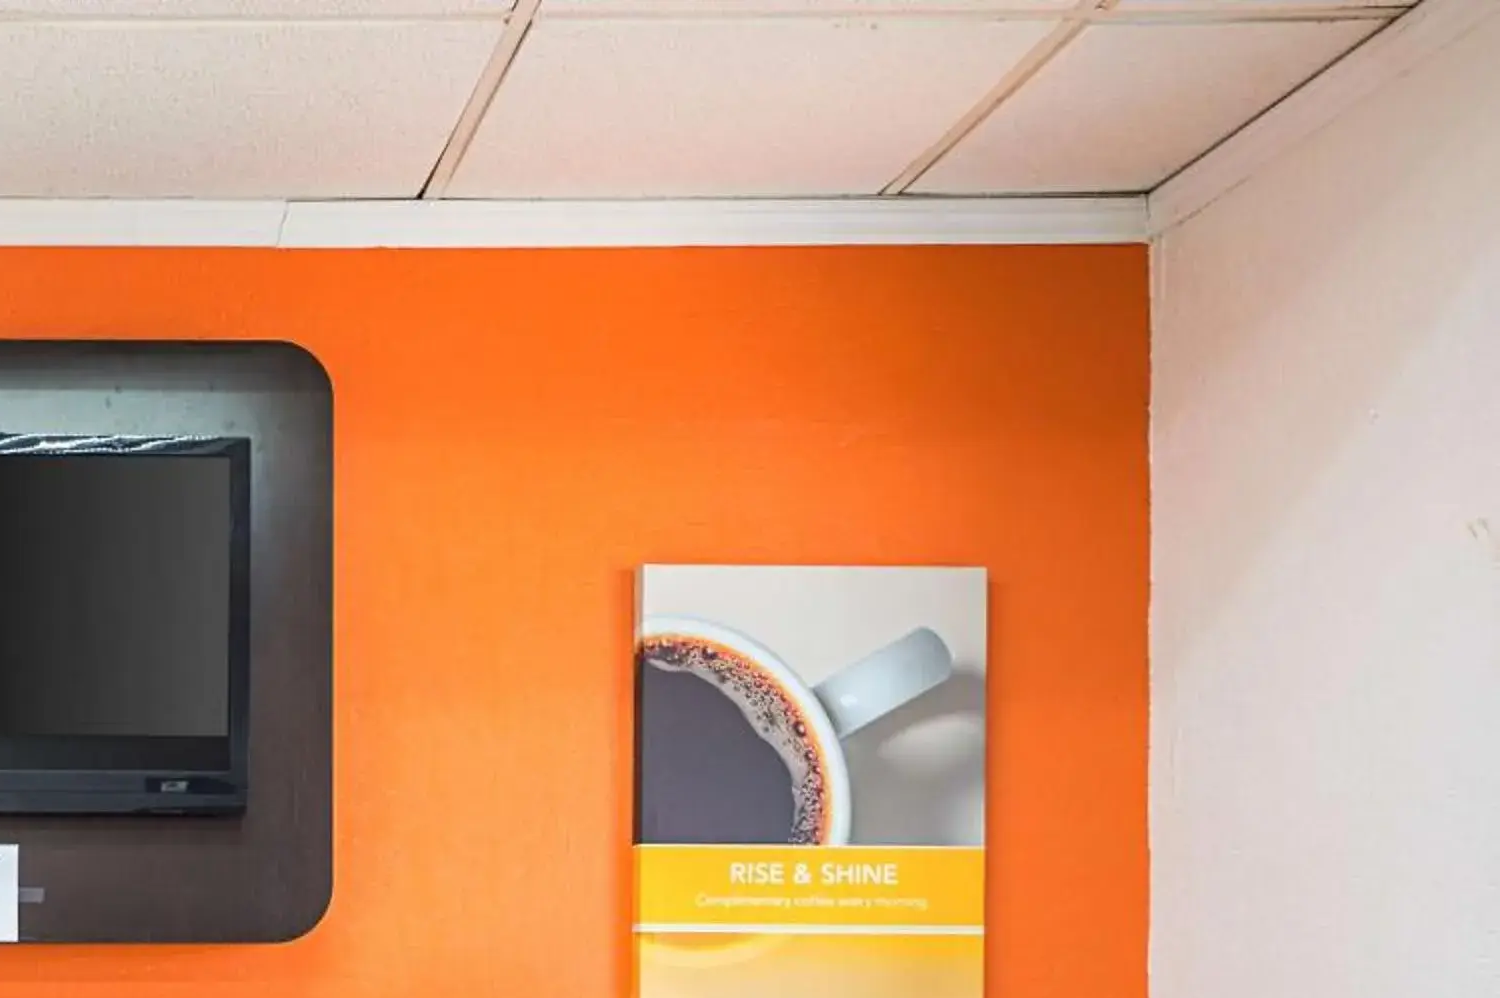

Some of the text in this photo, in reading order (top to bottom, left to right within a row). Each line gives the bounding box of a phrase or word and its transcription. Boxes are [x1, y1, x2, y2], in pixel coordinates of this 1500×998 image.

[729, 862, 898, 885] RISE & SHINE
